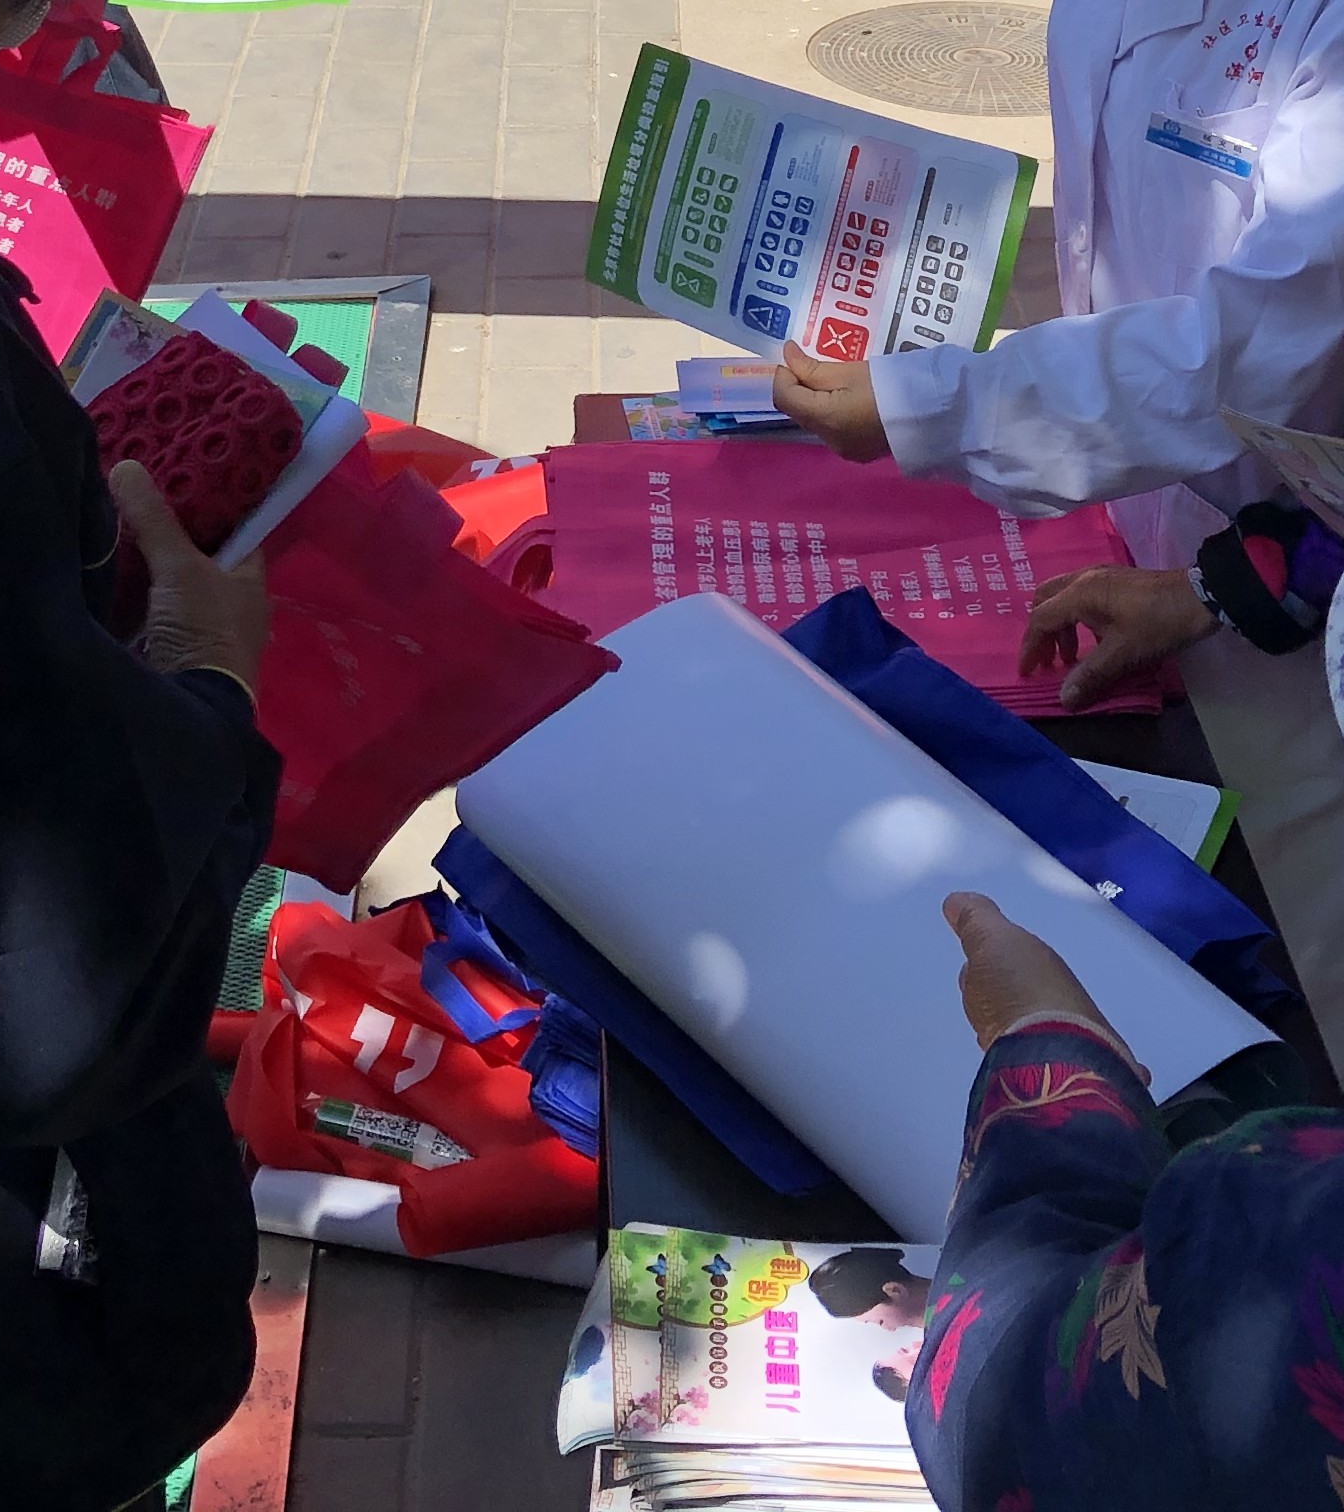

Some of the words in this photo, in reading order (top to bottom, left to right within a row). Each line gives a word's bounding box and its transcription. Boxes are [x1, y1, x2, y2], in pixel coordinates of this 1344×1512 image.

[1225, 62, 1265, 86] 滨河
[648, 471, 679, 608] 签约管理的重点人群
[744, 1257, 802, 1304] 保健
[764, 1309, 801, 1414] 儿童中医
